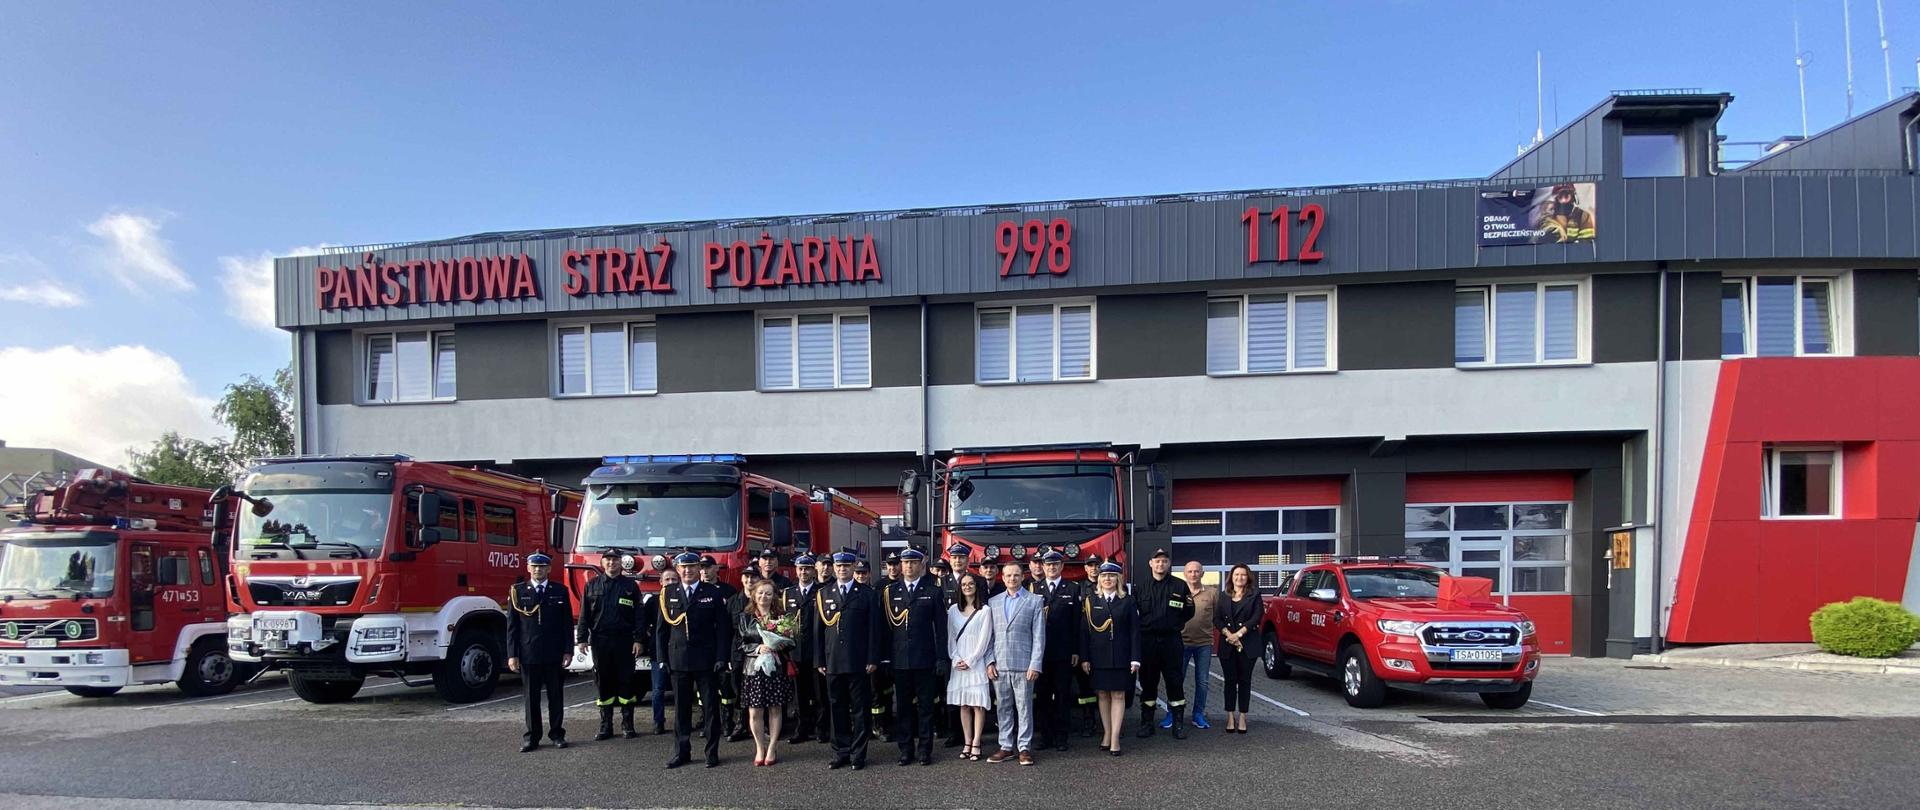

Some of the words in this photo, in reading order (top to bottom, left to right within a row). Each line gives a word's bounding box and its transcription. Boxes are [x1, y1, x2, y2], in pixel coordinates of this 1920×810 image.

[994, 217, 1073, 277] 998
[1241, 203, 1326, 263] 112
[1483, 229, 1546, 239] BEZPIECZEŃSTWO
[315, 252, 537, 310] PAŃSTWOWA
[561, 237, 673, 295] STRAŻ
[704, 230, 882, 290] POŻARNA
